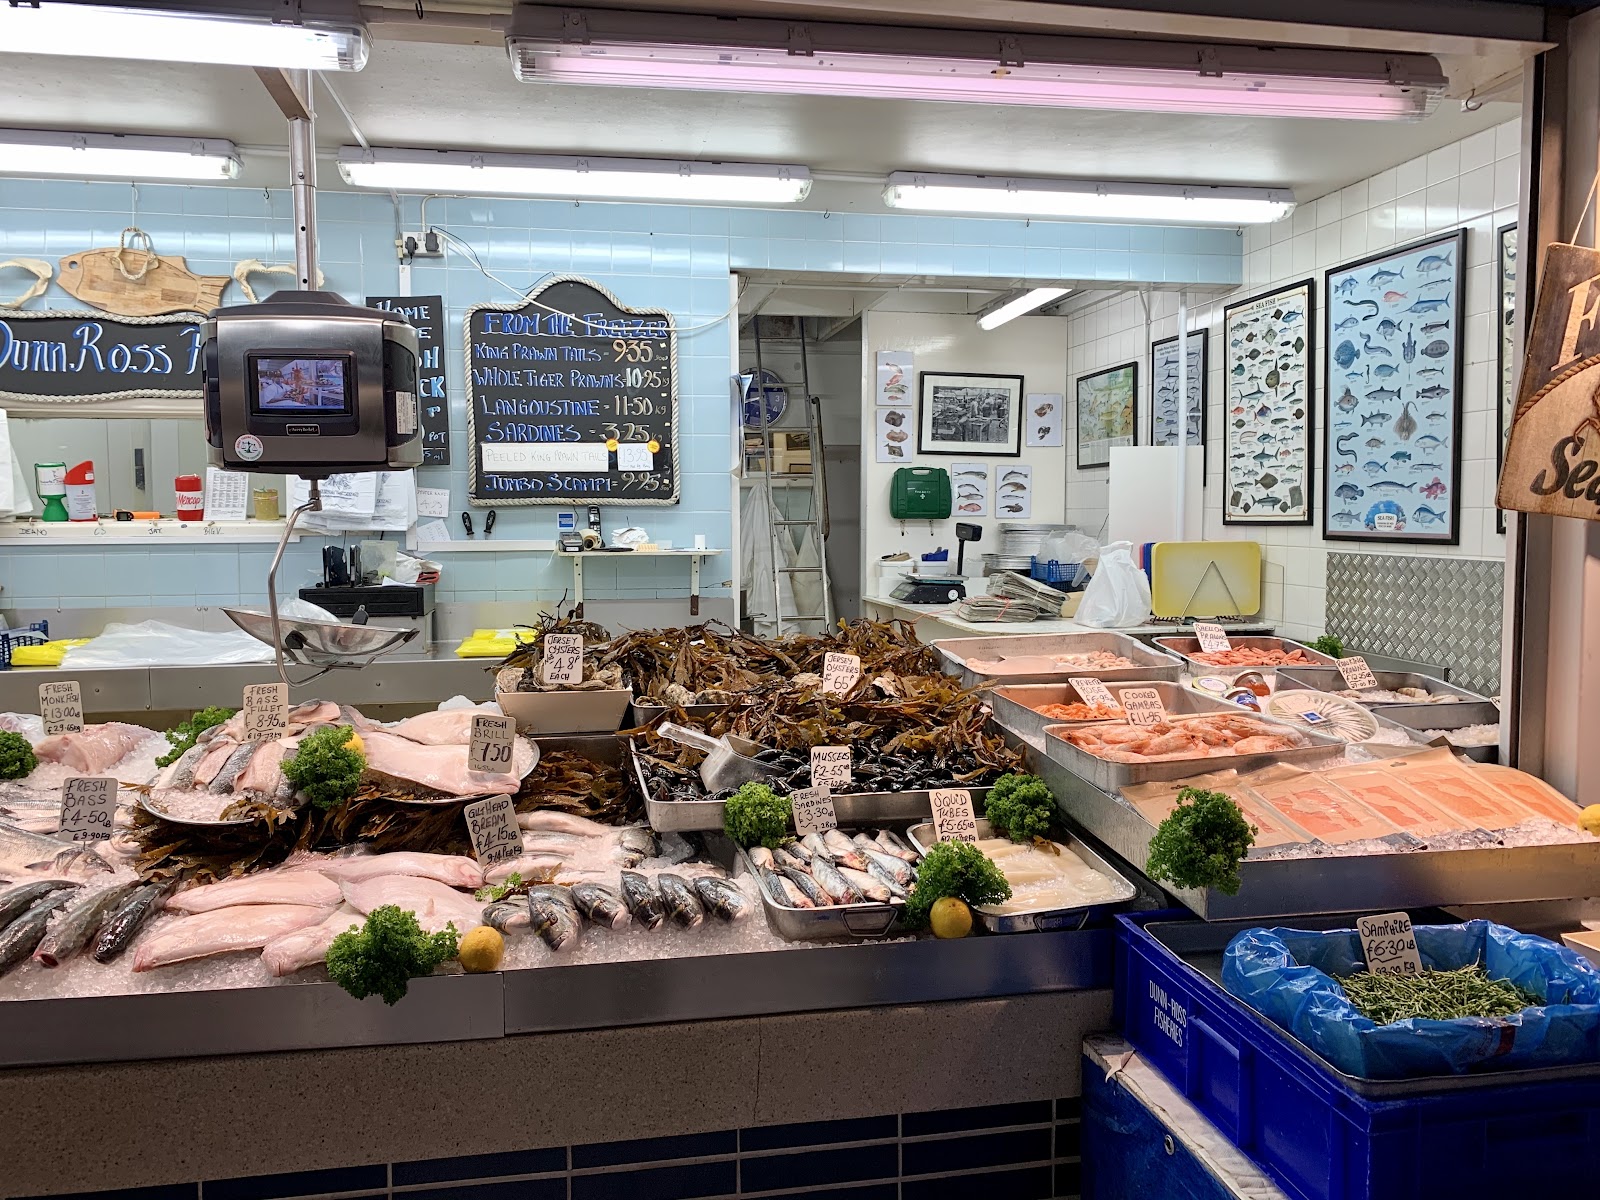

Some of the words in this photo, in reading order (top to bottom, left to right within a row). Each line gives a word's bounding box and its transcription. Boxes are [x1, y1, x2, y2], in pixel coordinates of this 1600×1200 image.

[484, 313, 540, 335] FROM
[542, 313, 576, 335] THE
[583, 313, 669, 338] FREEZER
[69, 322, 172, 374] Ross
[475, 342, 509, 360] KING
[512, 342, 558, 361] PRAWN
[559, 345, 601, 362] TAILS
[472, 366, 523, 388] WHOLE
[523, 369, 566, 388] TIGER
[480, 395, 600, 416] LANGOUSTINE
[485, 421, 582, 442] SARDINES
[486, 449, 527, 462] PEELED
[531, 449, 551, 462] KING
[484, 474, 544, 492] JUMBO
[547, 634, 578, 645] JERSEY
[548, 644, 580, 655] OYSTERS
[828, 654, 853, 664] JERSEY
[826, 663, 859, 674] OYSTERS
[550, 672, 570, 680] EACH
[45, 683, 73, 694] FRESH
[250, 685, 278, 696] FRESH
[246, 695, 279, 707] BASS
[1124, 690, 1157, 700] COOKED
[250, 704, 283, 715] FILLET
[1124, 700, 1161, 711] GAMBAS
[476, 717, 507, 729] FRESH
[473, 727, 509, 739] BRILL
[812, 752, 850, 763] MUSSELS
[66, 778, 107, 792] FRESH
[64, 793, 107, 808] BASS
[793, 790, 820, 802] FRESH
[794, 796, 832, 810] SARDINES
[936, 806, 969, 818] TUBES
[471, 813, 506, 834] BREAM
[1153, 1005, 1183, 1048] FISHERIES
